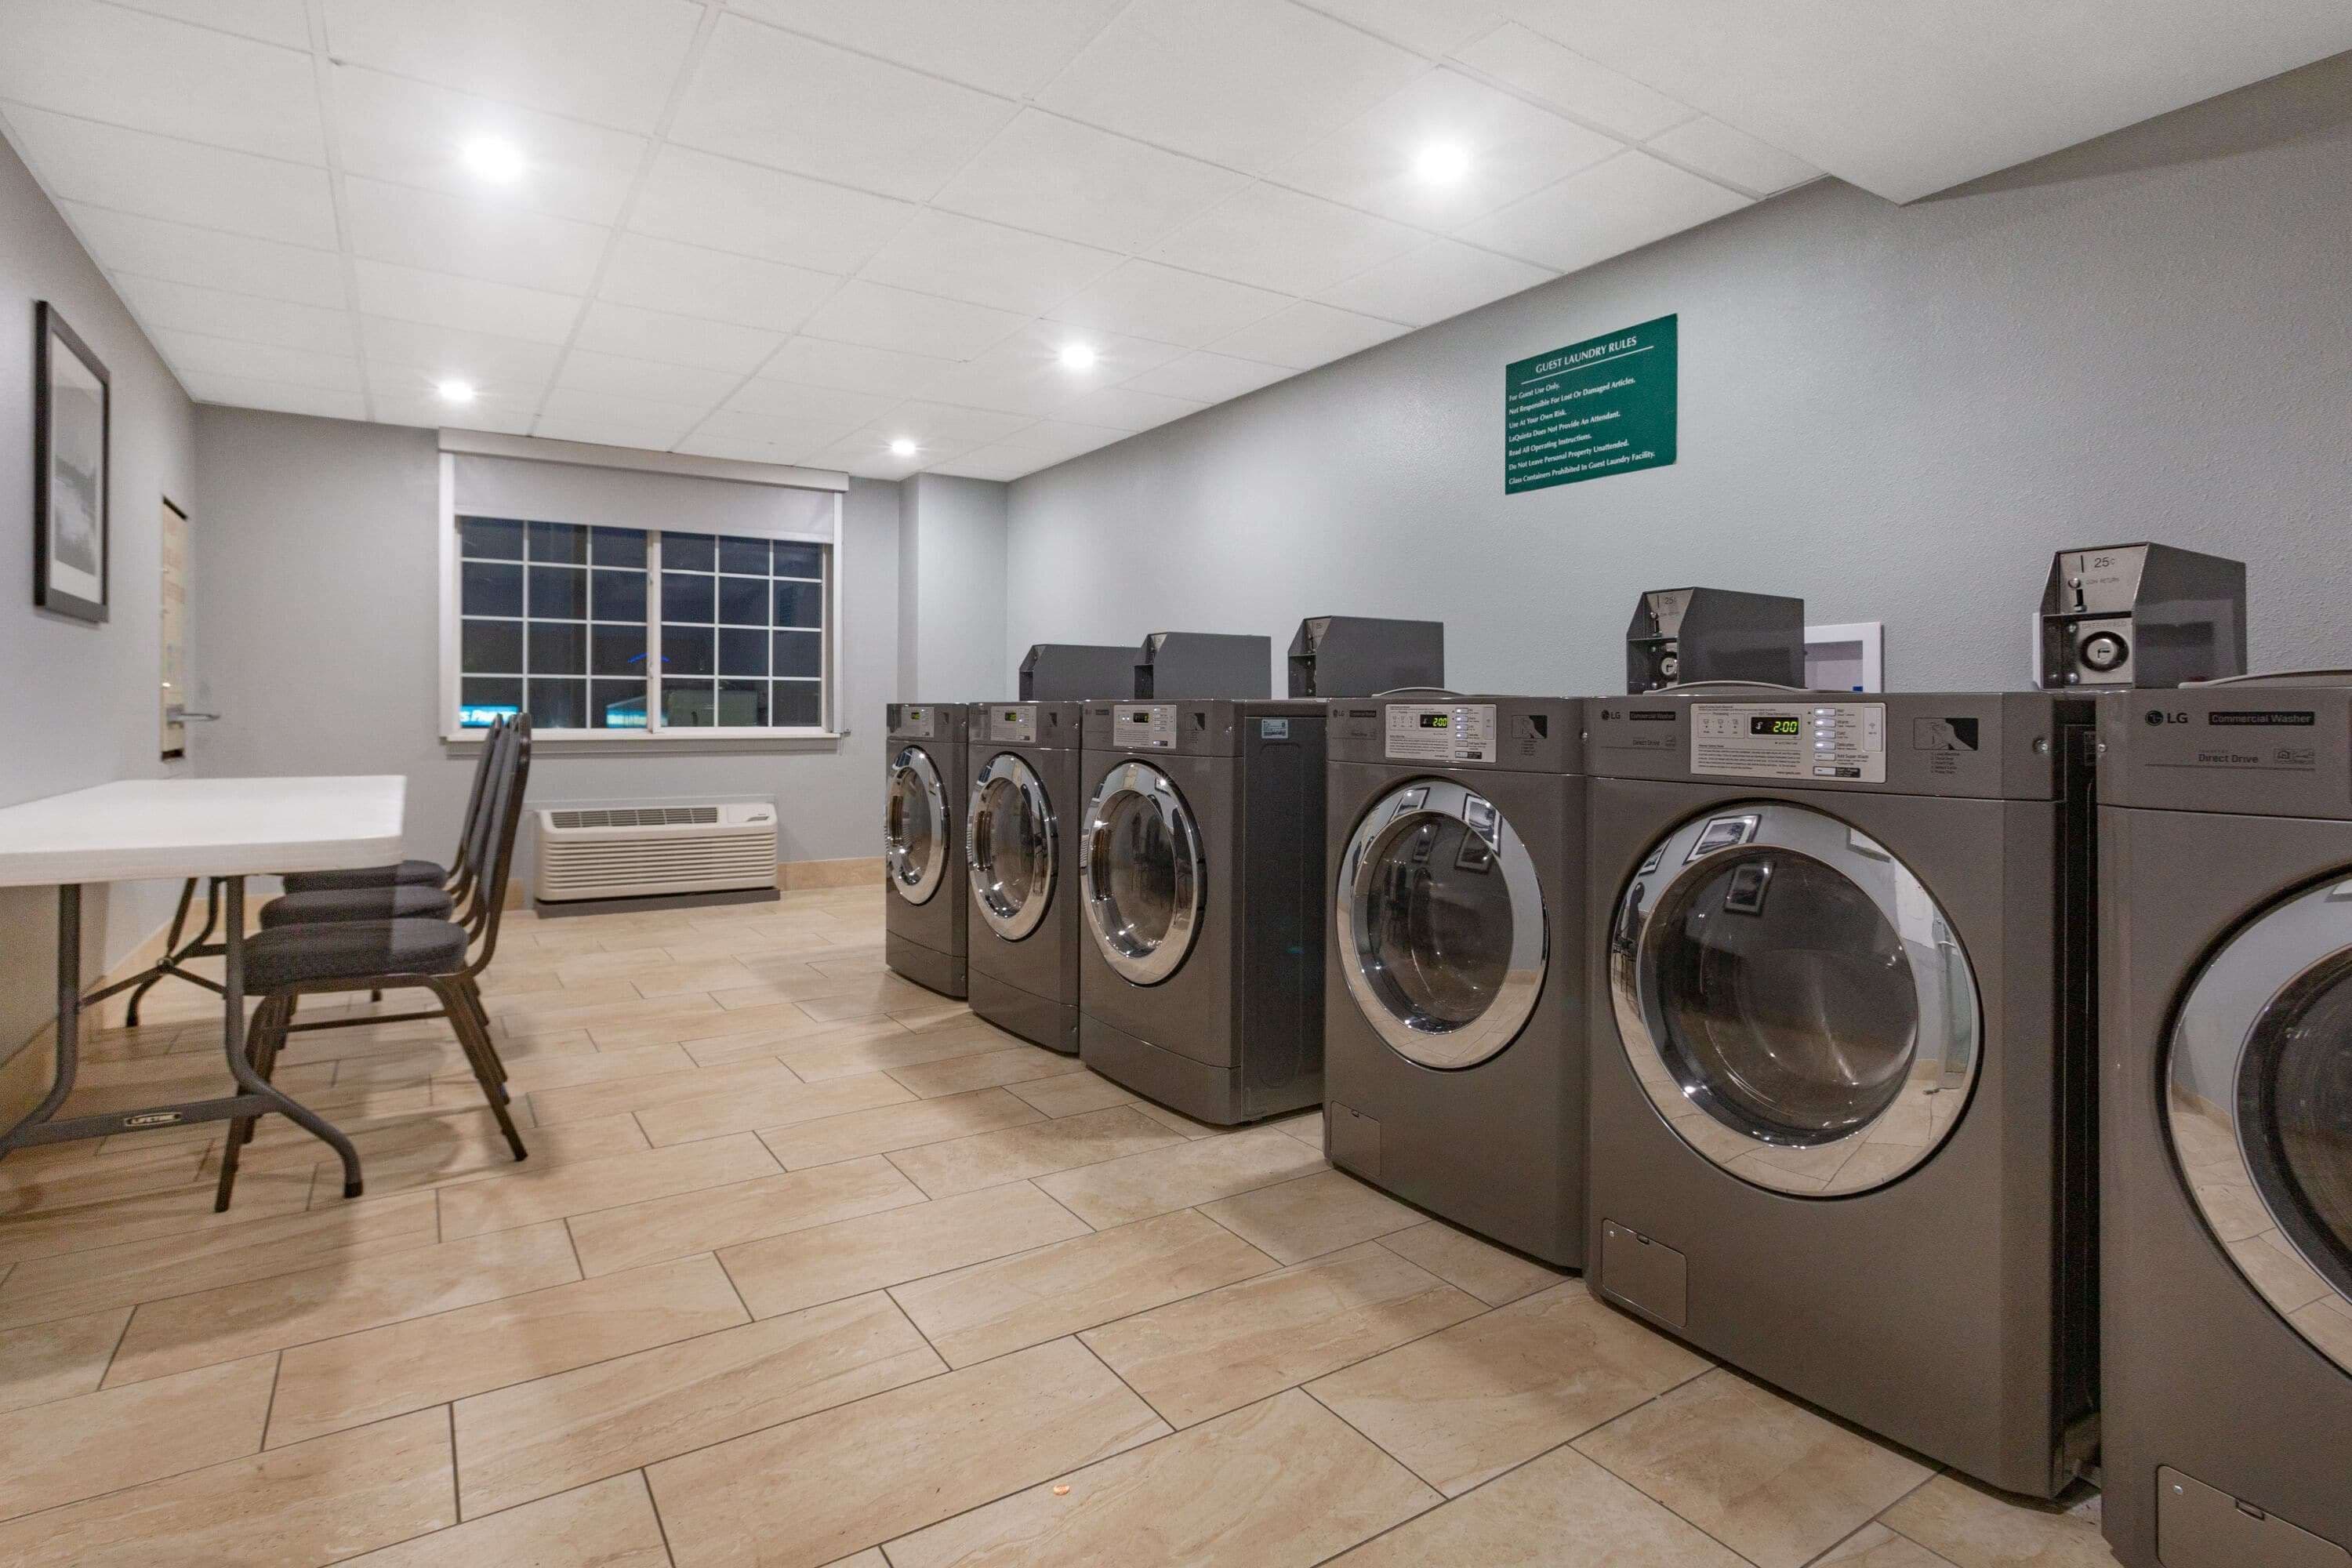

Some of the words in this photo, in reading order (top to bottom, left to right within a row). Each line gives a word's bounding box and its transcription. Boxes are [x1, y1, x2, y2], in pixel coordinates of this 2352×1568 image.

[1536, 358, 1562, 373] GUEST
[1564, 345, 1606, 365] LAUNDRY
[1609, 336, 1637, 353] RULES
[1519, 390, 1534, 399] Guest
[1520, 399, 1549, 412] Responsible
[1583, 382, 1610, 396] Damaged
[1611, 377, 1635, 389] Articles.
[1508, 432, 1532, 442] LaQuinta
[1559, 419, 1580, 430] Provide
[1590, 411, 1621, 423] Attendant.
[1530, 441, 1557, 452] Operating
[1558, 434, 1592, 445] Instructions.
[1544, 452, 1567, 463] Personal
[1568, 448, 1592, 458] Property
[1593, 439, 1630, 452] Unattended.
[1523, 472, 1551, 481] Containers
[1552, 464, 1581, 477] Prohibited
[1588, 460, 1606, 469] Guest
[1606, 456, 1630, 466] Laundry
[1632, 451, 1655, 461] Facility.
[2167, 713, 2188, 724] LG
[2211, 714, 2268, 723] Commercial
[2270, 714, 2312, 724] Washer
[2198, 753, 2229, 763] Direct
[2231, 754, 2259, 764] Drive
